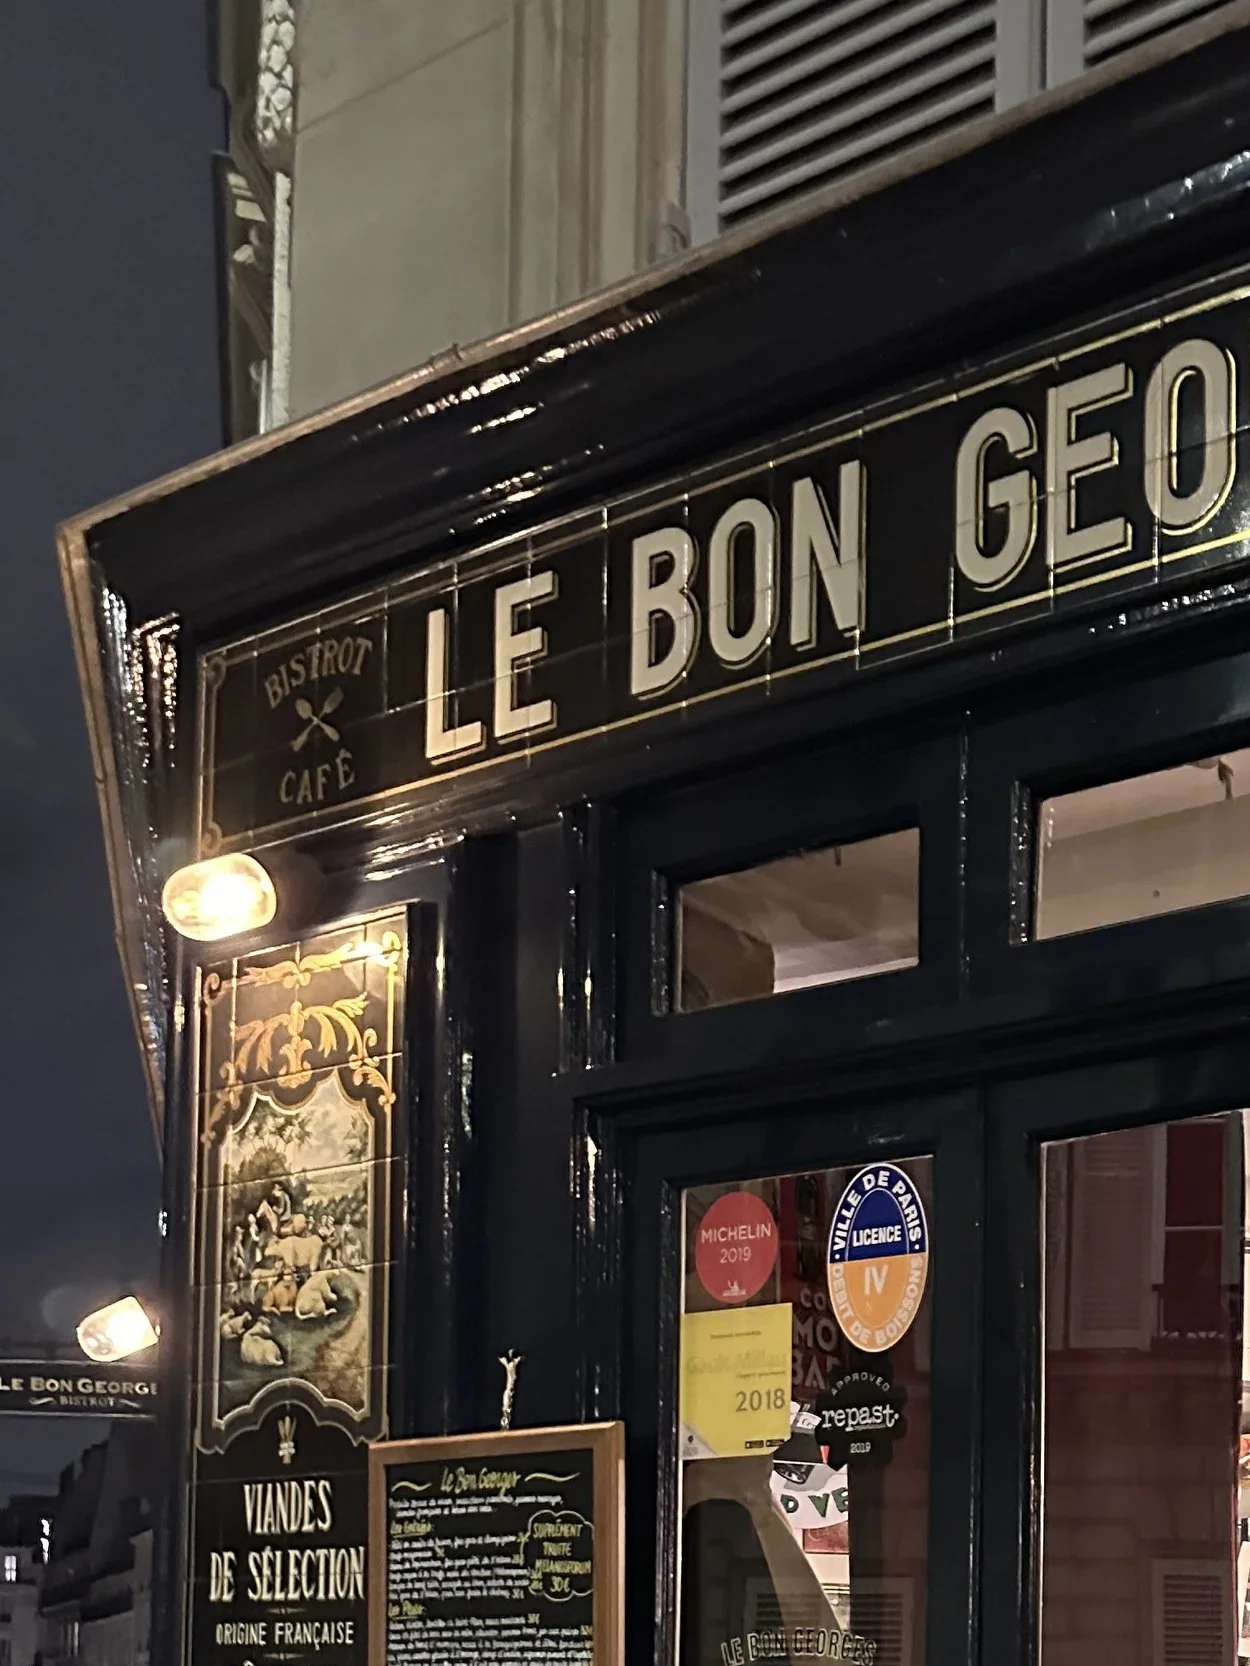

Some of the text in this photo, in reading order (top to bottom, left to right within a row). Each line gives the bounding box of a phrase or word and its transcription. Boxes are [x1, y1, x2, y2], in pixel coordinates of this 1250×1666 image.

[424, 568, 558, 765] LE
[629, 458, 867, 700] BON
[264, 636, 373, 709] BISTROT
[833, 1170, 922, 1250] VILLE DE PARIS
[700, 1223, 772, 1242] MICHELIN
[852, 1225, 902, 1247] LICENCE
[719, 1248, 752, 1265] 2019
[863, 1263, 889, 1296] IV
[850, 1321, 872, 1345] DE
[875, 1254, 923, 1346] BOISSONS
[30, 1376, 73, 1393] BON
[77, 1378, 158, 1395] GEORGE
[735, 1388, 786, 1413] 2018
[830, 1371, 891, 1397] APPROVED
[243, 1479, 333, 1536] VIANDES
[209, 1550, 237, 1602] DE
[247, 1545, 366, 1602] SÉLECTION
[216, 1621, 354, 1651] ORIGINE FRANÇAISE
[747, 1627, 787, 1662] BON
